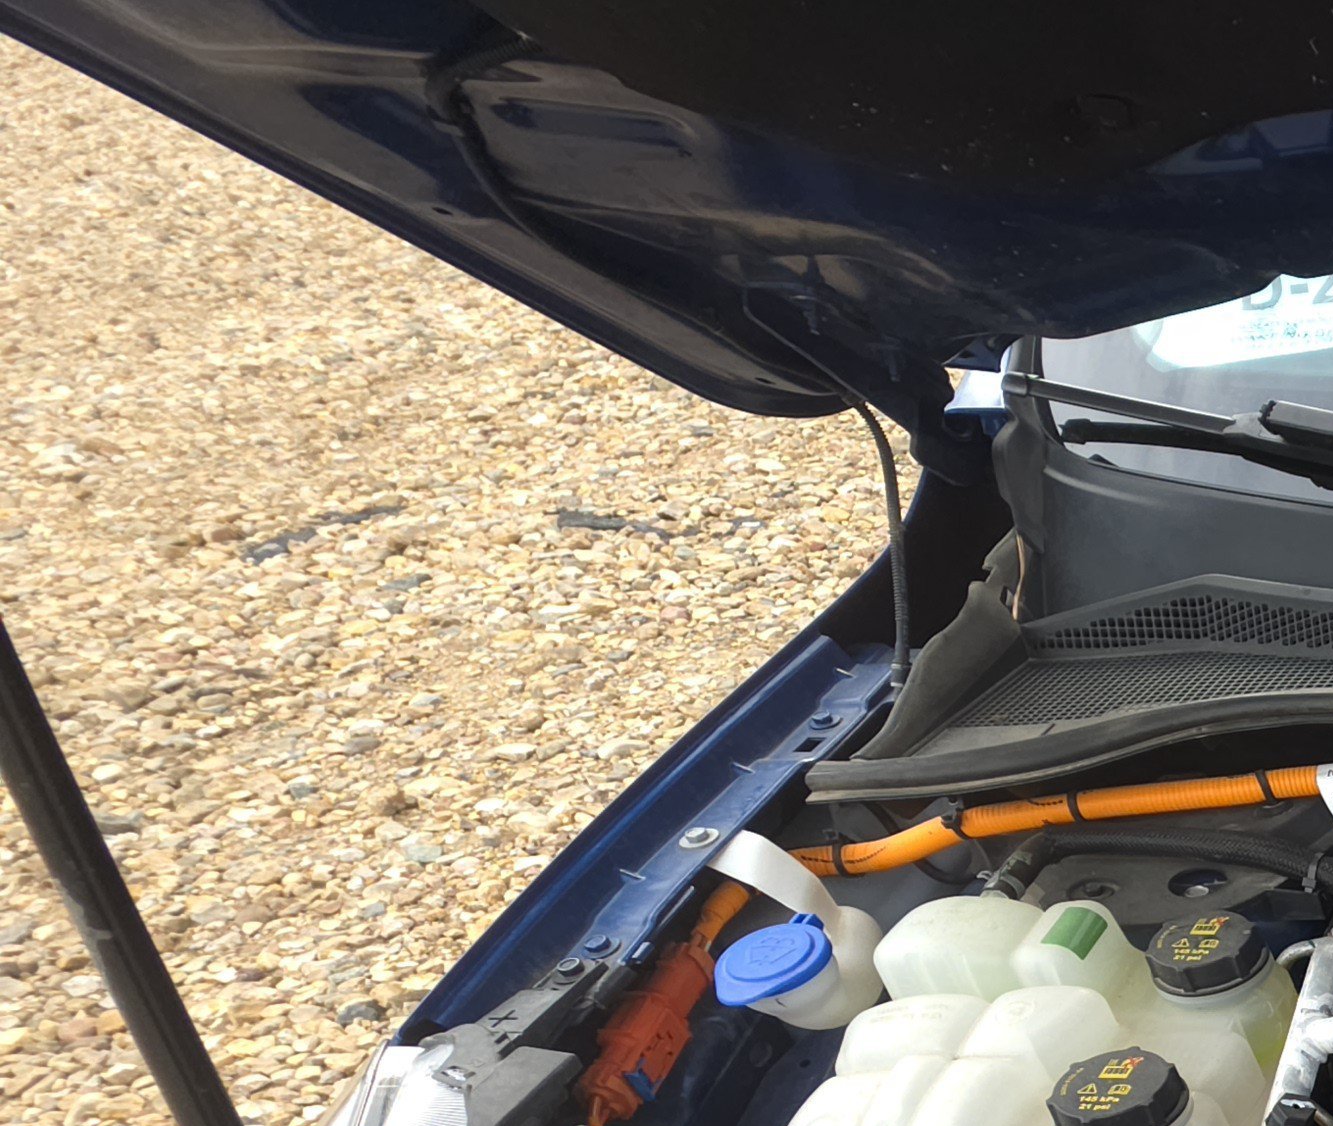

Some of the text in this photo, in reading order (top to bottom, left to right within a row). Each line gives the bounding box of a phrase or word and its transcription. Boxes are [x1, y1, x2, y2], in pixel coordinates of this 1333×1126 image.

[1079, 1095, 1098, 1103] 145
[1078, 1103, 1112, 1111] 21 psi
